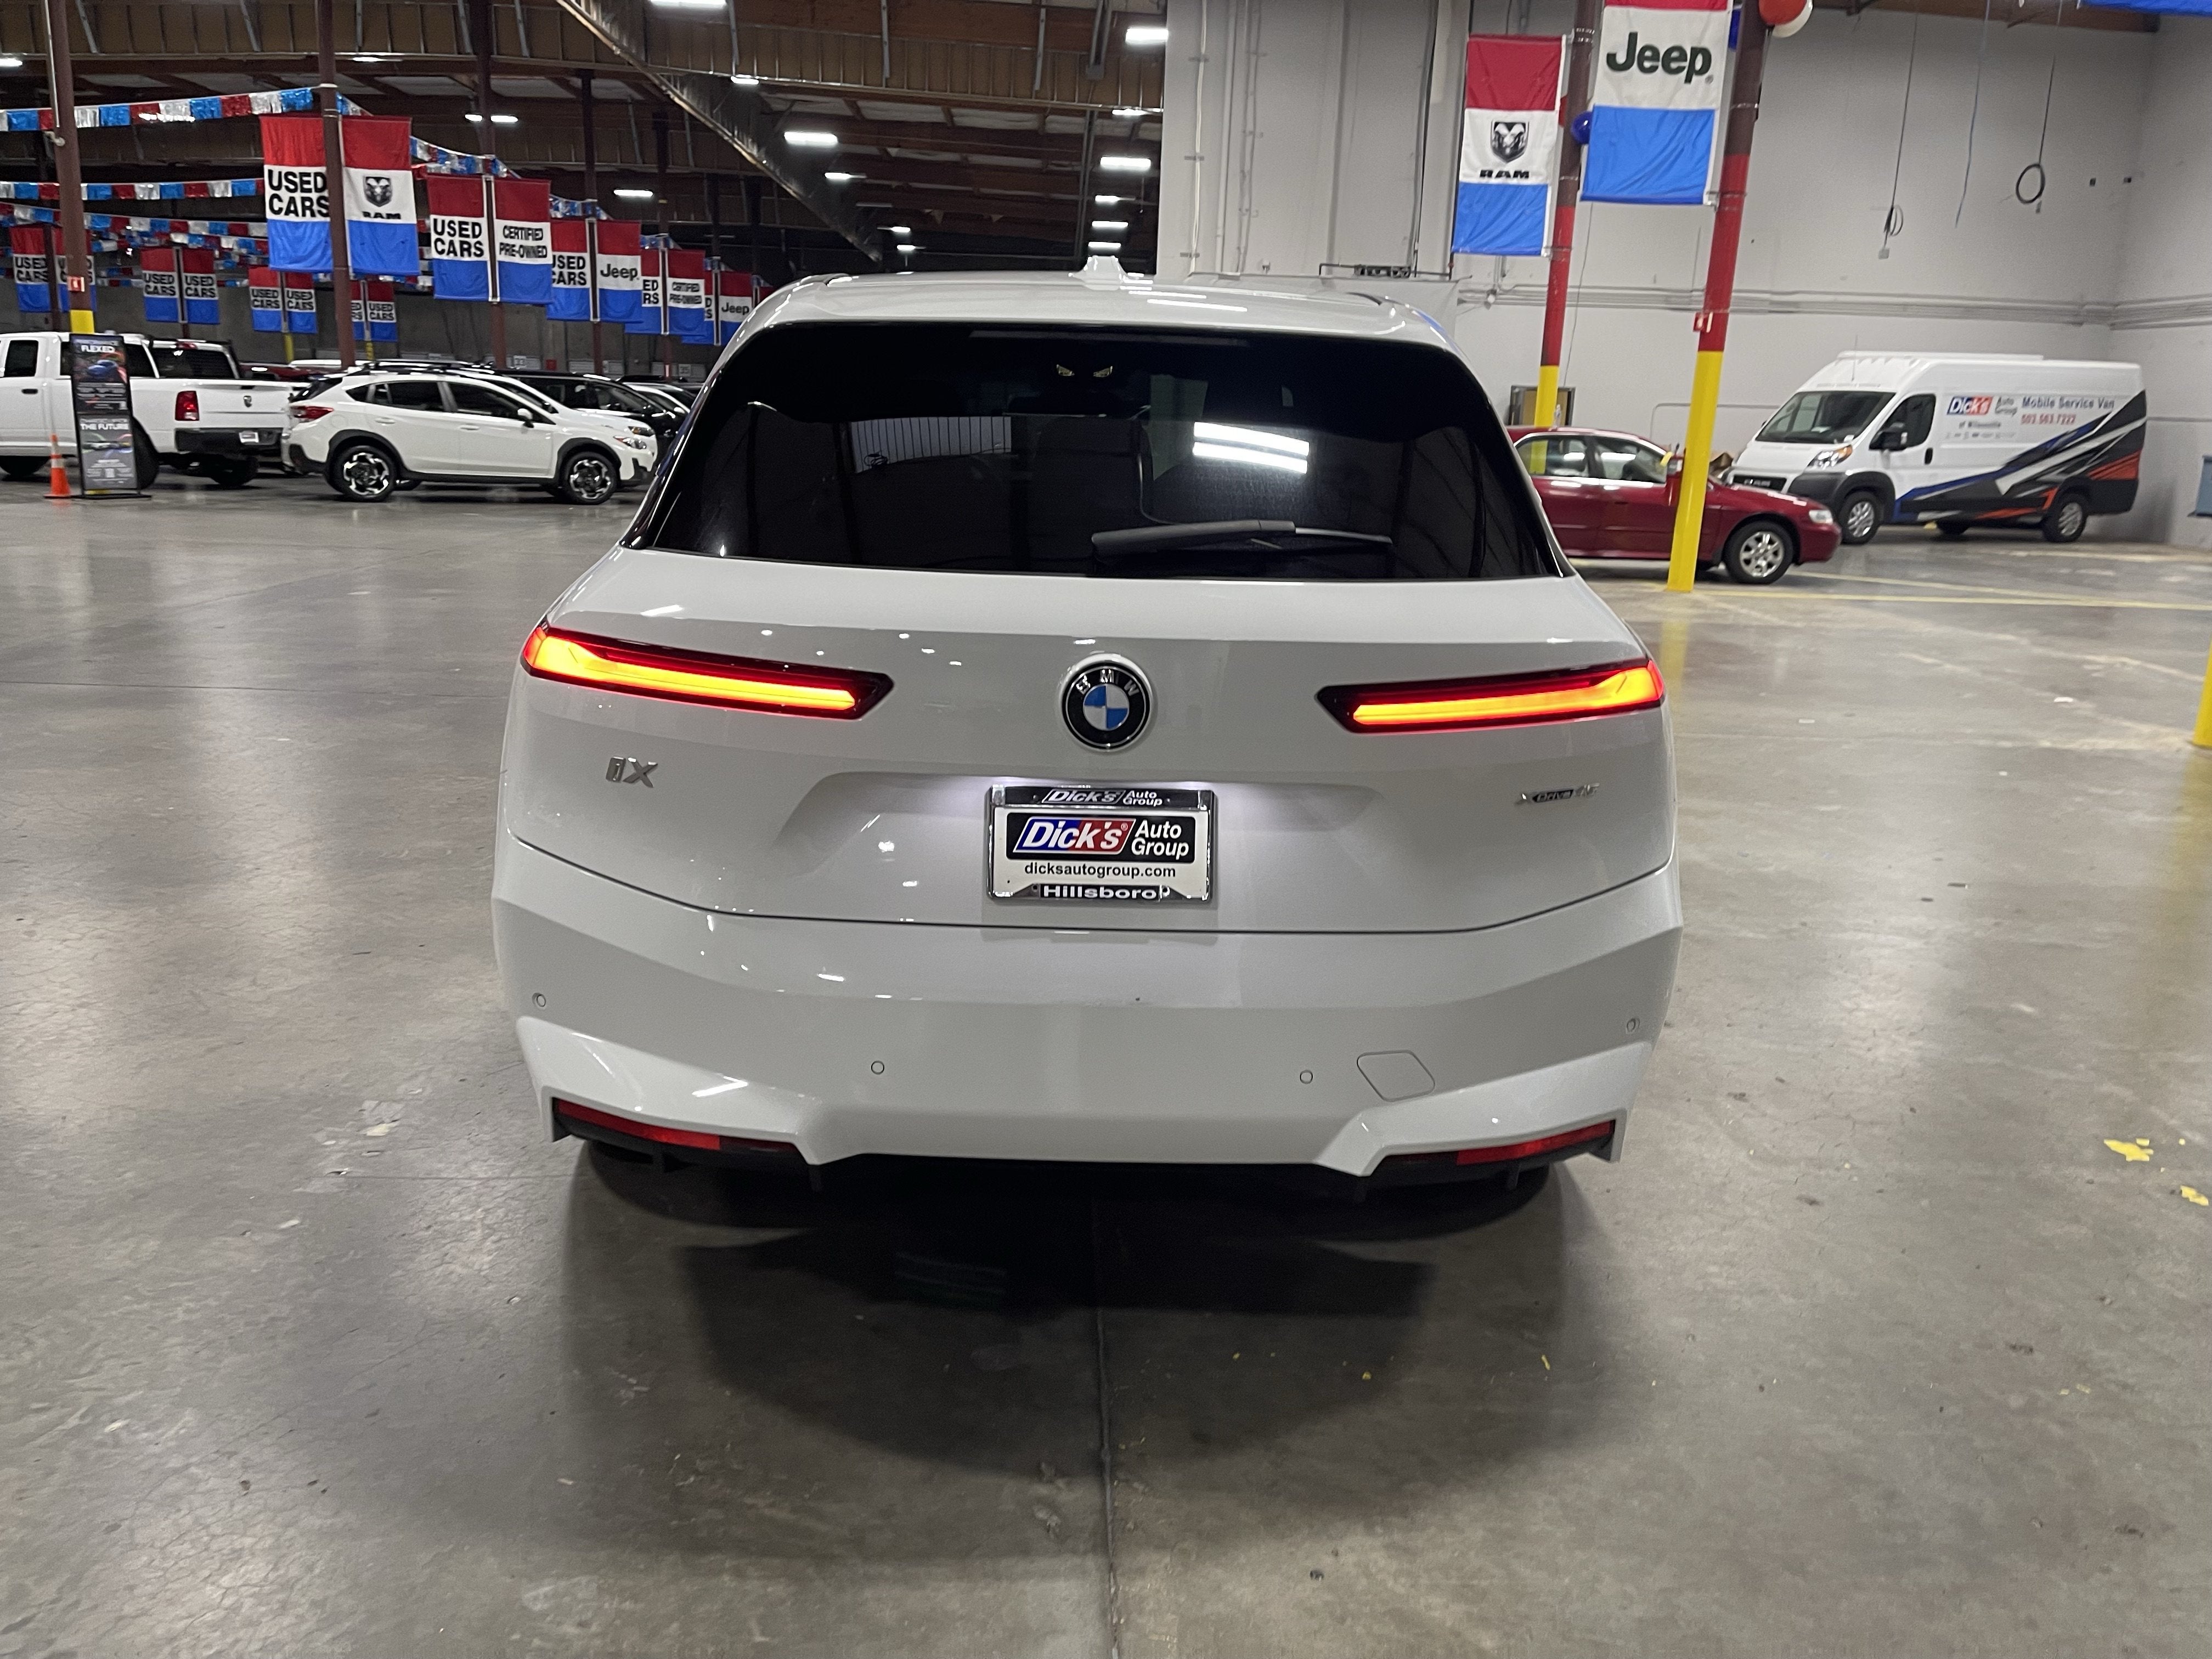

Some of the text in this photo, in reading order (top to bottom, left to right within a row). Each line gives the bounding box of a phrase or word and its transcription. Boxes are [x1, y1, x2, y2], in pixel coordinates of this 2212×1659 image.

[1606, 31, 1712, 84] Jeep
[1480, 170, 1530, 178] RAM
[268, 170, 327, 193] USED
[269, 194, 329, 217] CARS
[433, 218, 482, 239] USED
[503, 225, 544, 241] CERTIFIED
[434, 238, 484, 257] CARS
[499, 242, 548, 258] PRE-OWNED
[144, 273, 174, 284] USED
[600, 264, 638, 281] Jeep
[185, 275, 214, 286] USED
[643, 279, 658, 291] ED
[145, 285, 176, 296] CARS
[185, 287, 216, 297] CARS
[252, 289, 279, 298] USED
[286, 290, 313, 300] USED
[253, 299, 280, 308] CARS
[643, 293, 659, 304] RS
[369, 303, 393, 312] USED
[721, 302, 749, 315] Jeep
[2022, 396, 2115, 409] Mobile Service Van
[1076, 669, 1139, 697] BMW
[1123, 797, 1162, 806] Group
[1023, 821, 1122, 849] Dick's
[1135, 820, 1182, 838] Auto
[1132, 838, 1189, 860] Group
[1025, 862, 1176, 878] dicksautogroup.com
[1044, 885, 1156, 899] Hillsboro
